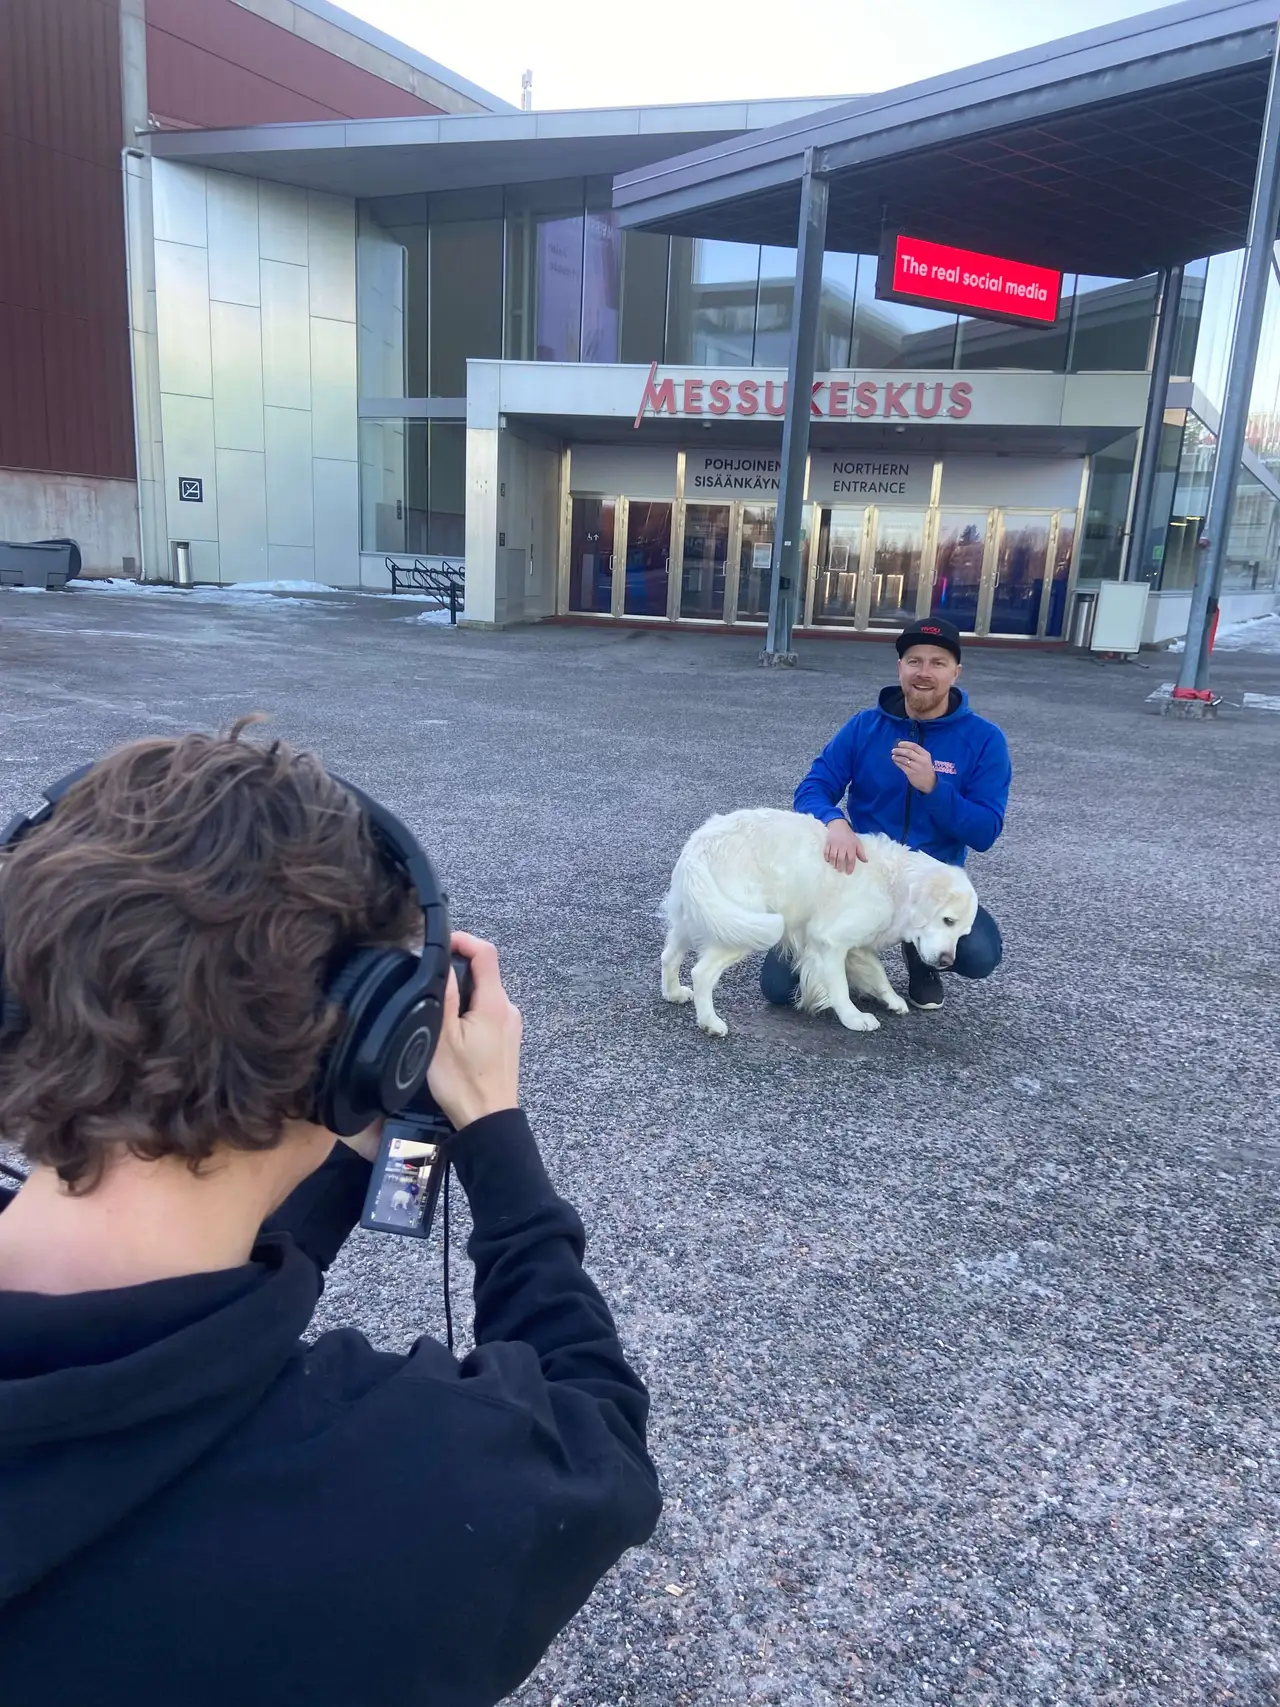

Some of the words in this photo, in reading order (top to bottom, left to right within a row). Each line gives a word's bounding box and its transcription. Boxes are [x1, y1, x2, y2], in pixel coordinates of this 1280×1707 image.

[901, 255, 927, 277] The
[931, 266, 960, 284] real
[962, 273, 1003, 292] social
[1005, 282, 1048, 301] media
[833, 462, 909, 477] NORTHERN
[694, 475, 780, 490] SISÄÄNKÄYN
[834, 480, 906, 494] ENTRANCE
